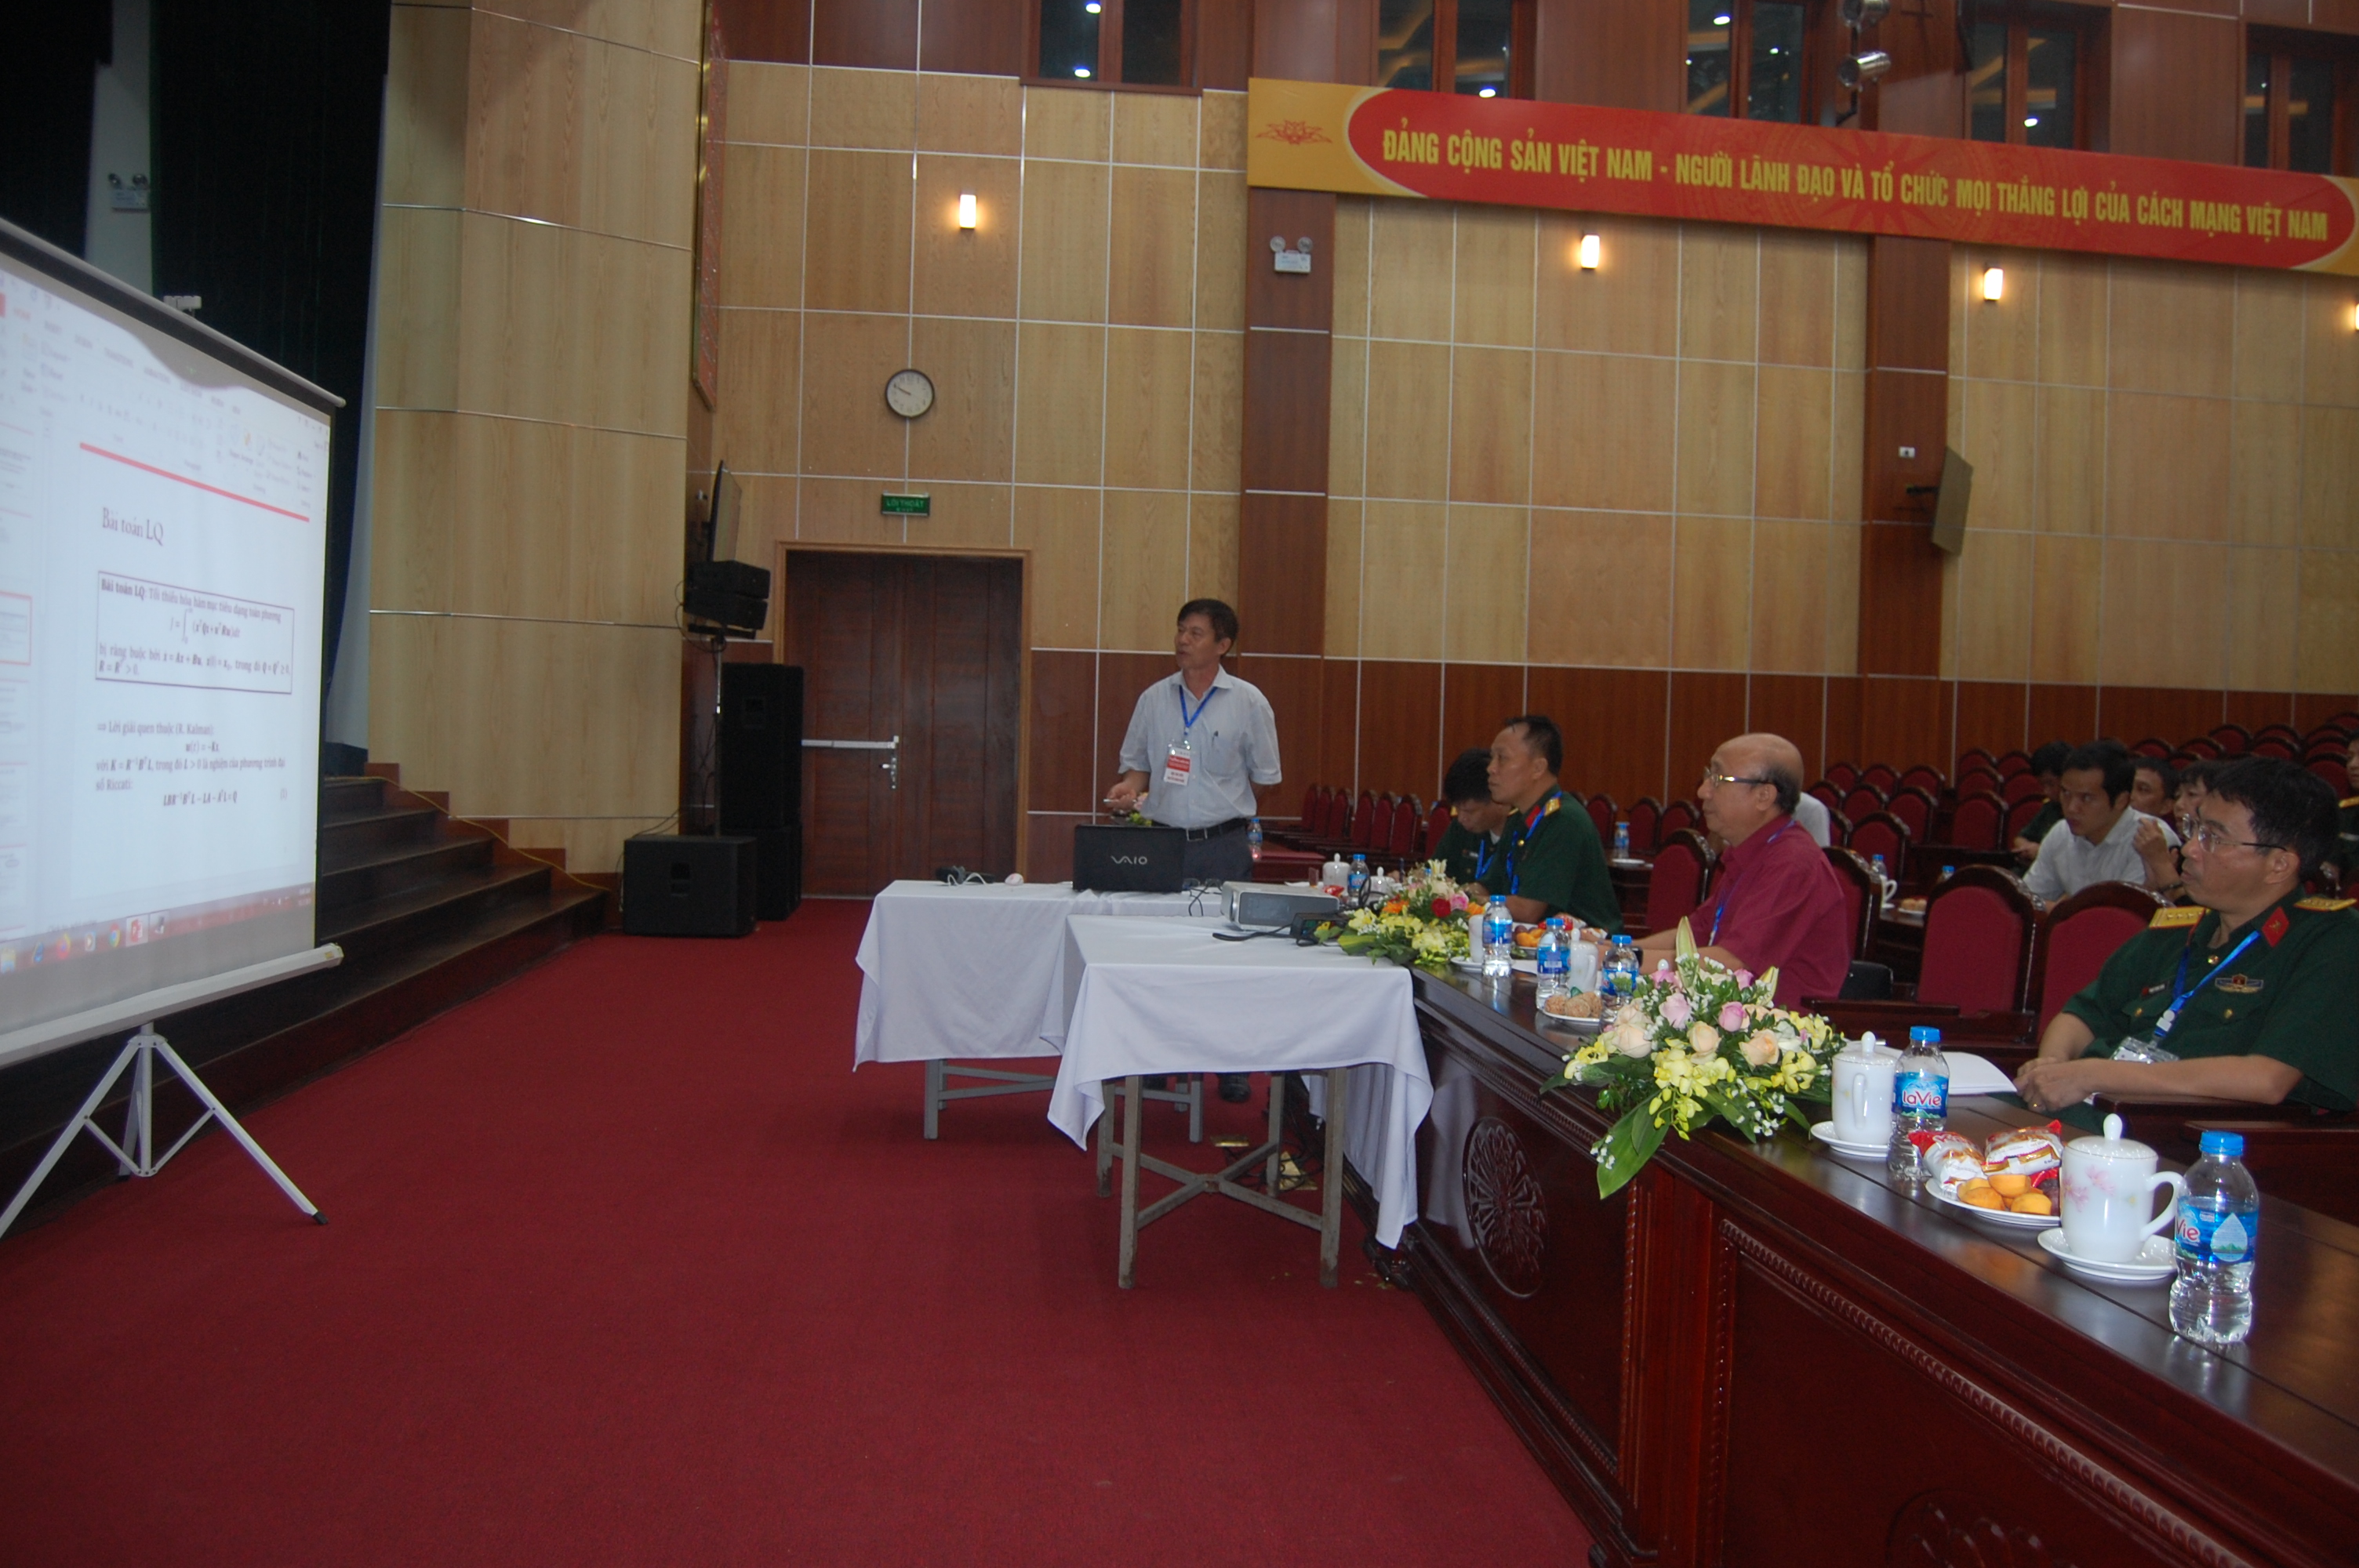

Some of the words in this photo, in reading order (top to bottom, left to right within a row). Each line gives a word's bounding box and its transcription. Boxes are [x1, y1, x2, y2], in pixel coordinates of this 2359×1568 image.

[1383, 117, 1439, 165] ĐẢNG
[1448, 129, 1503, 174] CỘNG
[1510, 127, 1552, 174] SẢN
[1558, 138, 1599, 183] VIỆT
[1607, 147, 1652, 181] NAM
[1659, 165, 1668, 174] -
[1675, 150, 1733, 189] NGƯỜI
[1740, 154, 1790, 193] LÃNH
[1797, 164, 1836, 203] ĐẠO
[1841, 163, 1866, 201] VÀ
[1870, 160, 1894, 202] TỔ
[1900, 169, 1949, 207] CHỨC
[1956, 178, 1992, 218] MỌI
[1997, 174, 2055, 216] THẮNG
[2062, 185, 2088, 226] LỢI
[2095, 180, 2131, 223] CỦA
[2137, 191, 2183, 228] CÁCH
[2190, 200, 2242, 238] MẠNG
[2246, 201, 2282, 243] VIỆT
[2288, 209, 2328, 241] NAM
[103, 506, 118, 532] Bài
[122, 517, 143, 538] toán
[147, 518, 163, 546] LQ
[1110, 855, 1147, 865] VAIO
[2176, 1219, 2199, 1241] Vie
